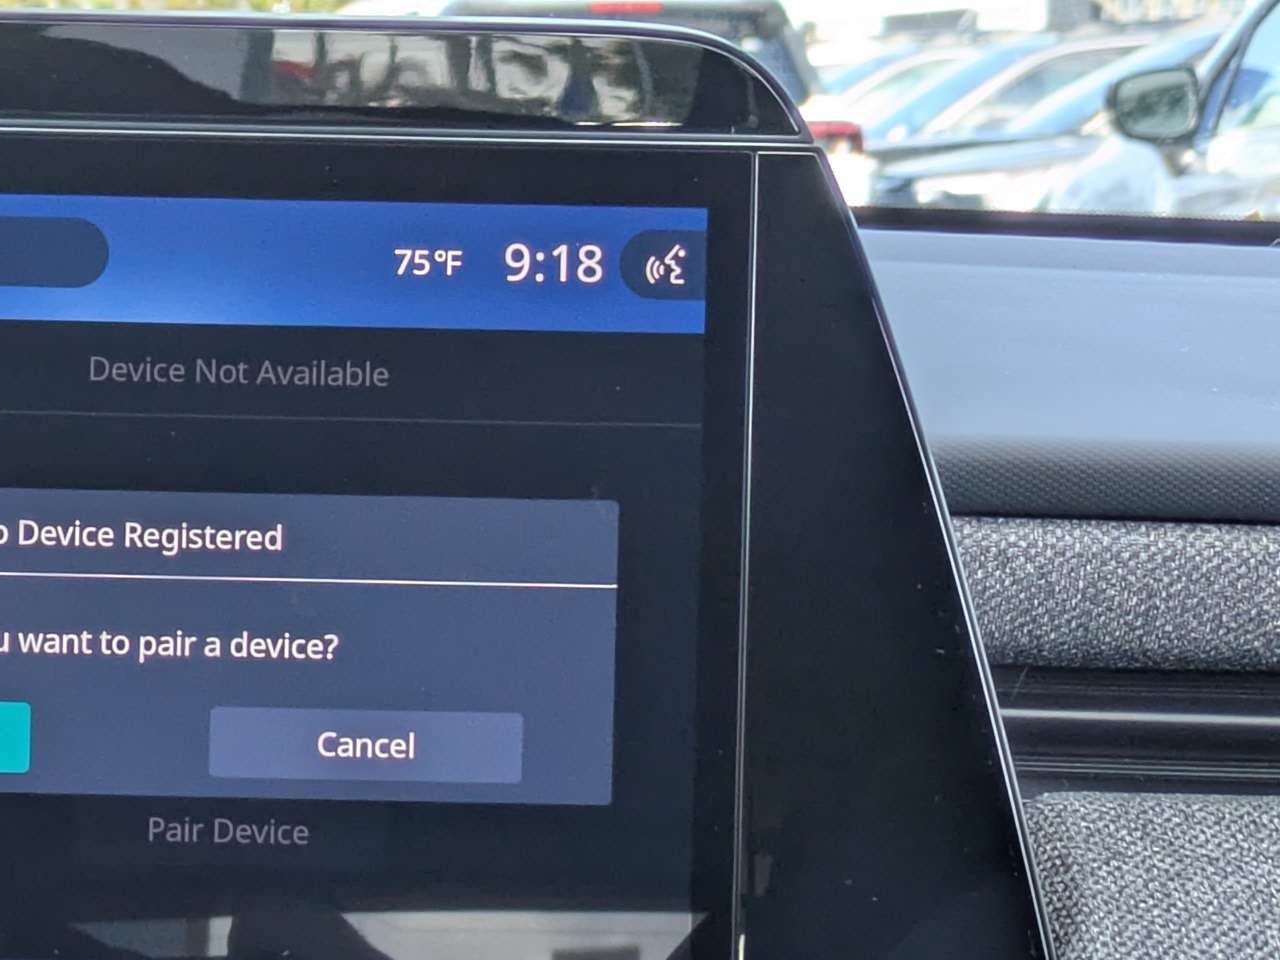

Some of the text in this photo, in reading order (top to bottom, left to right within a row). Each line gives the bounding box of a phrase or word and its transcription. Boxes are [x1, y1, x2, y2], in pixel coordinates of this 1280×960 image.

[505, 243, 603, 283] 9:18
[89, 356, 389, 387] Device Not Available
[18, 519, 115, 547] Device
[124, 521, 283, 556] Registered
[17, 630, 93, 655] want
[99, 630, 130, 655] to
[138, 629, 198, 664] pair
[203, 636, 221, 657] a
[230, 630, 339, 660] device?
[317, 731, 415, 759] Cancel
[148, 816, 309, 845] Pair Device
